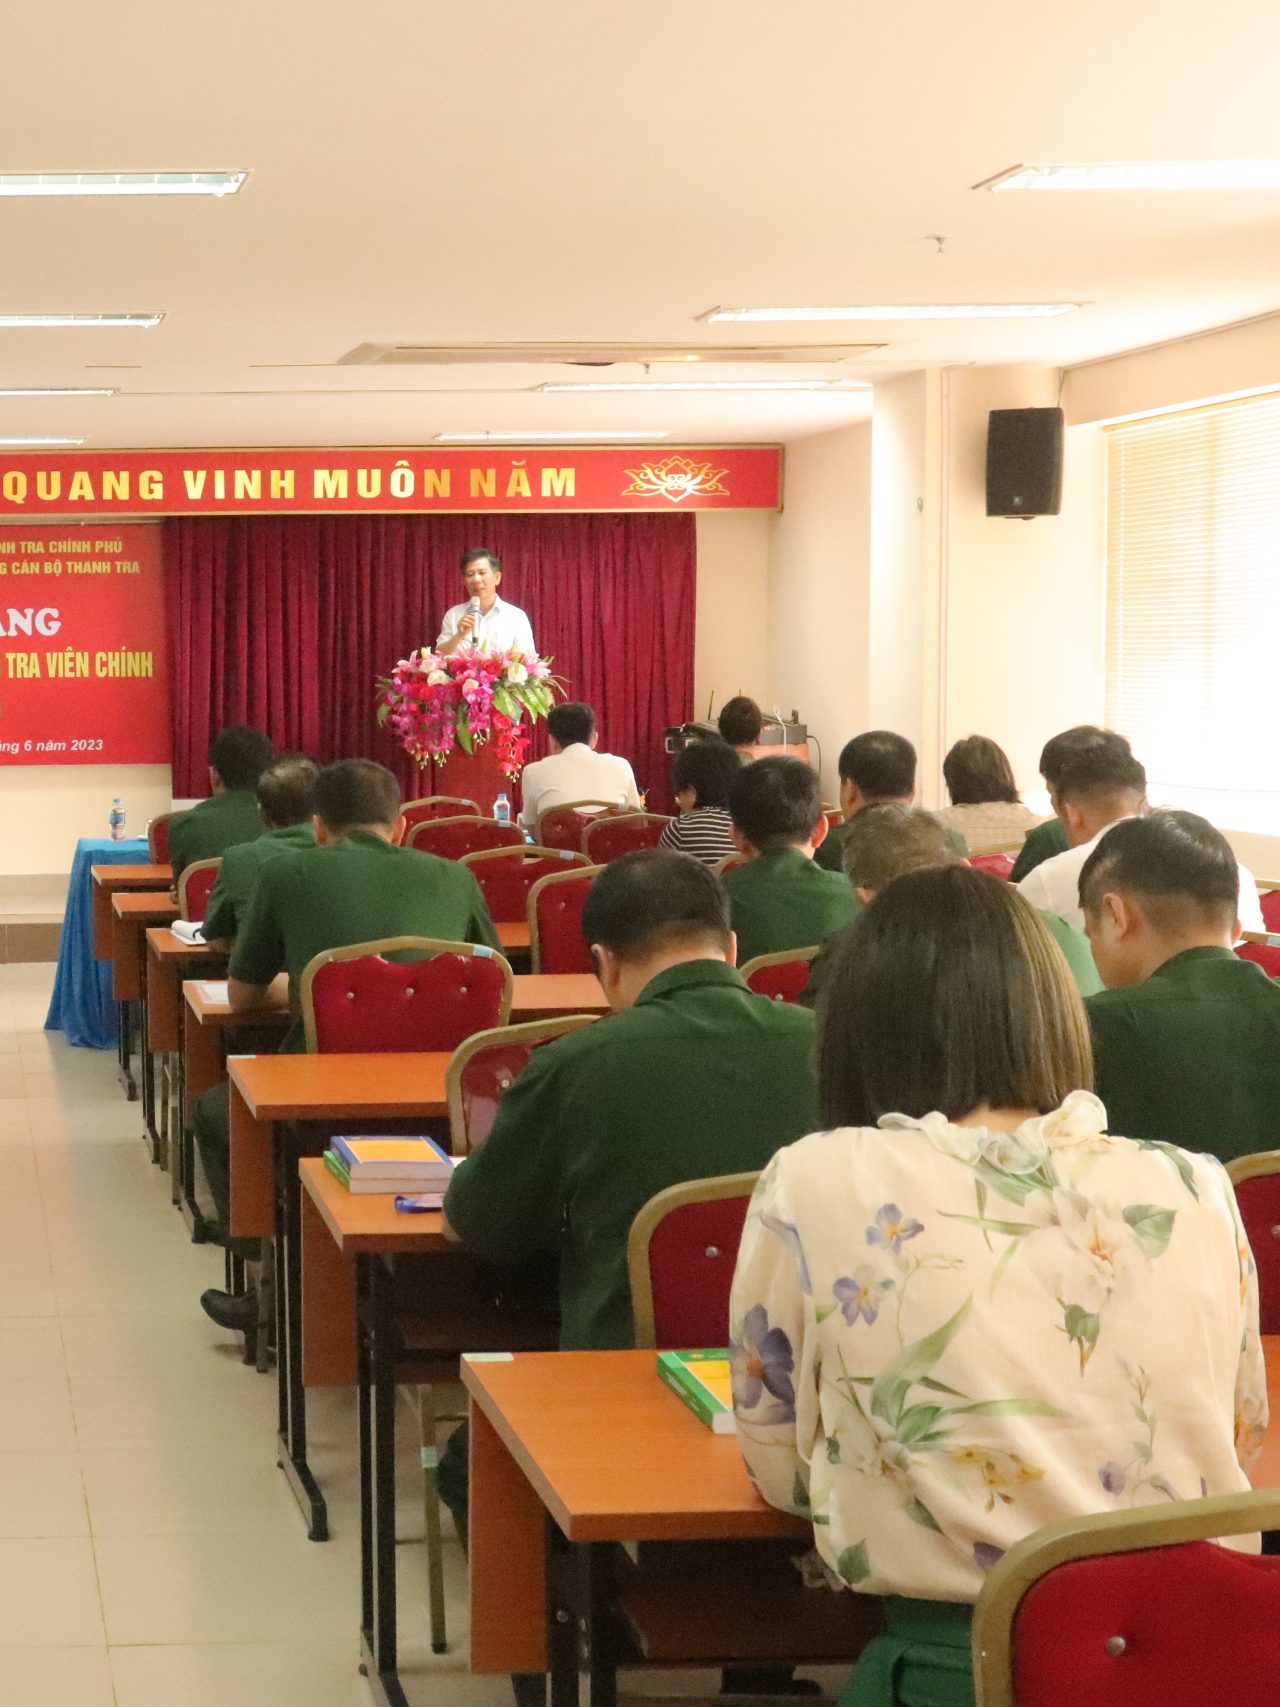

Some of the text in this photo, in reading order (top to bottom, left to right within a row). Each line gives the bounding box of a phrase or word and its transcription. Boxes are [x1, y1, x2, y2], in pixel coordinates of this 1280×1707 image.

[3, 470, 163, 504] QUANG
[183, 470, 294, 499] VINH
[314, 460, 450, 498] MUÔN
[470, 461, 575, 497] NĂM
[5, 653, 40, 678] TRA
[46, 646, 89, 677] VIÊN
[95, 646, 152, 677] CHÍNH
[24, 740, 32, 751] 6
[36, 740, 66, 751] năm
[71, 739, 103, 750] 2023
